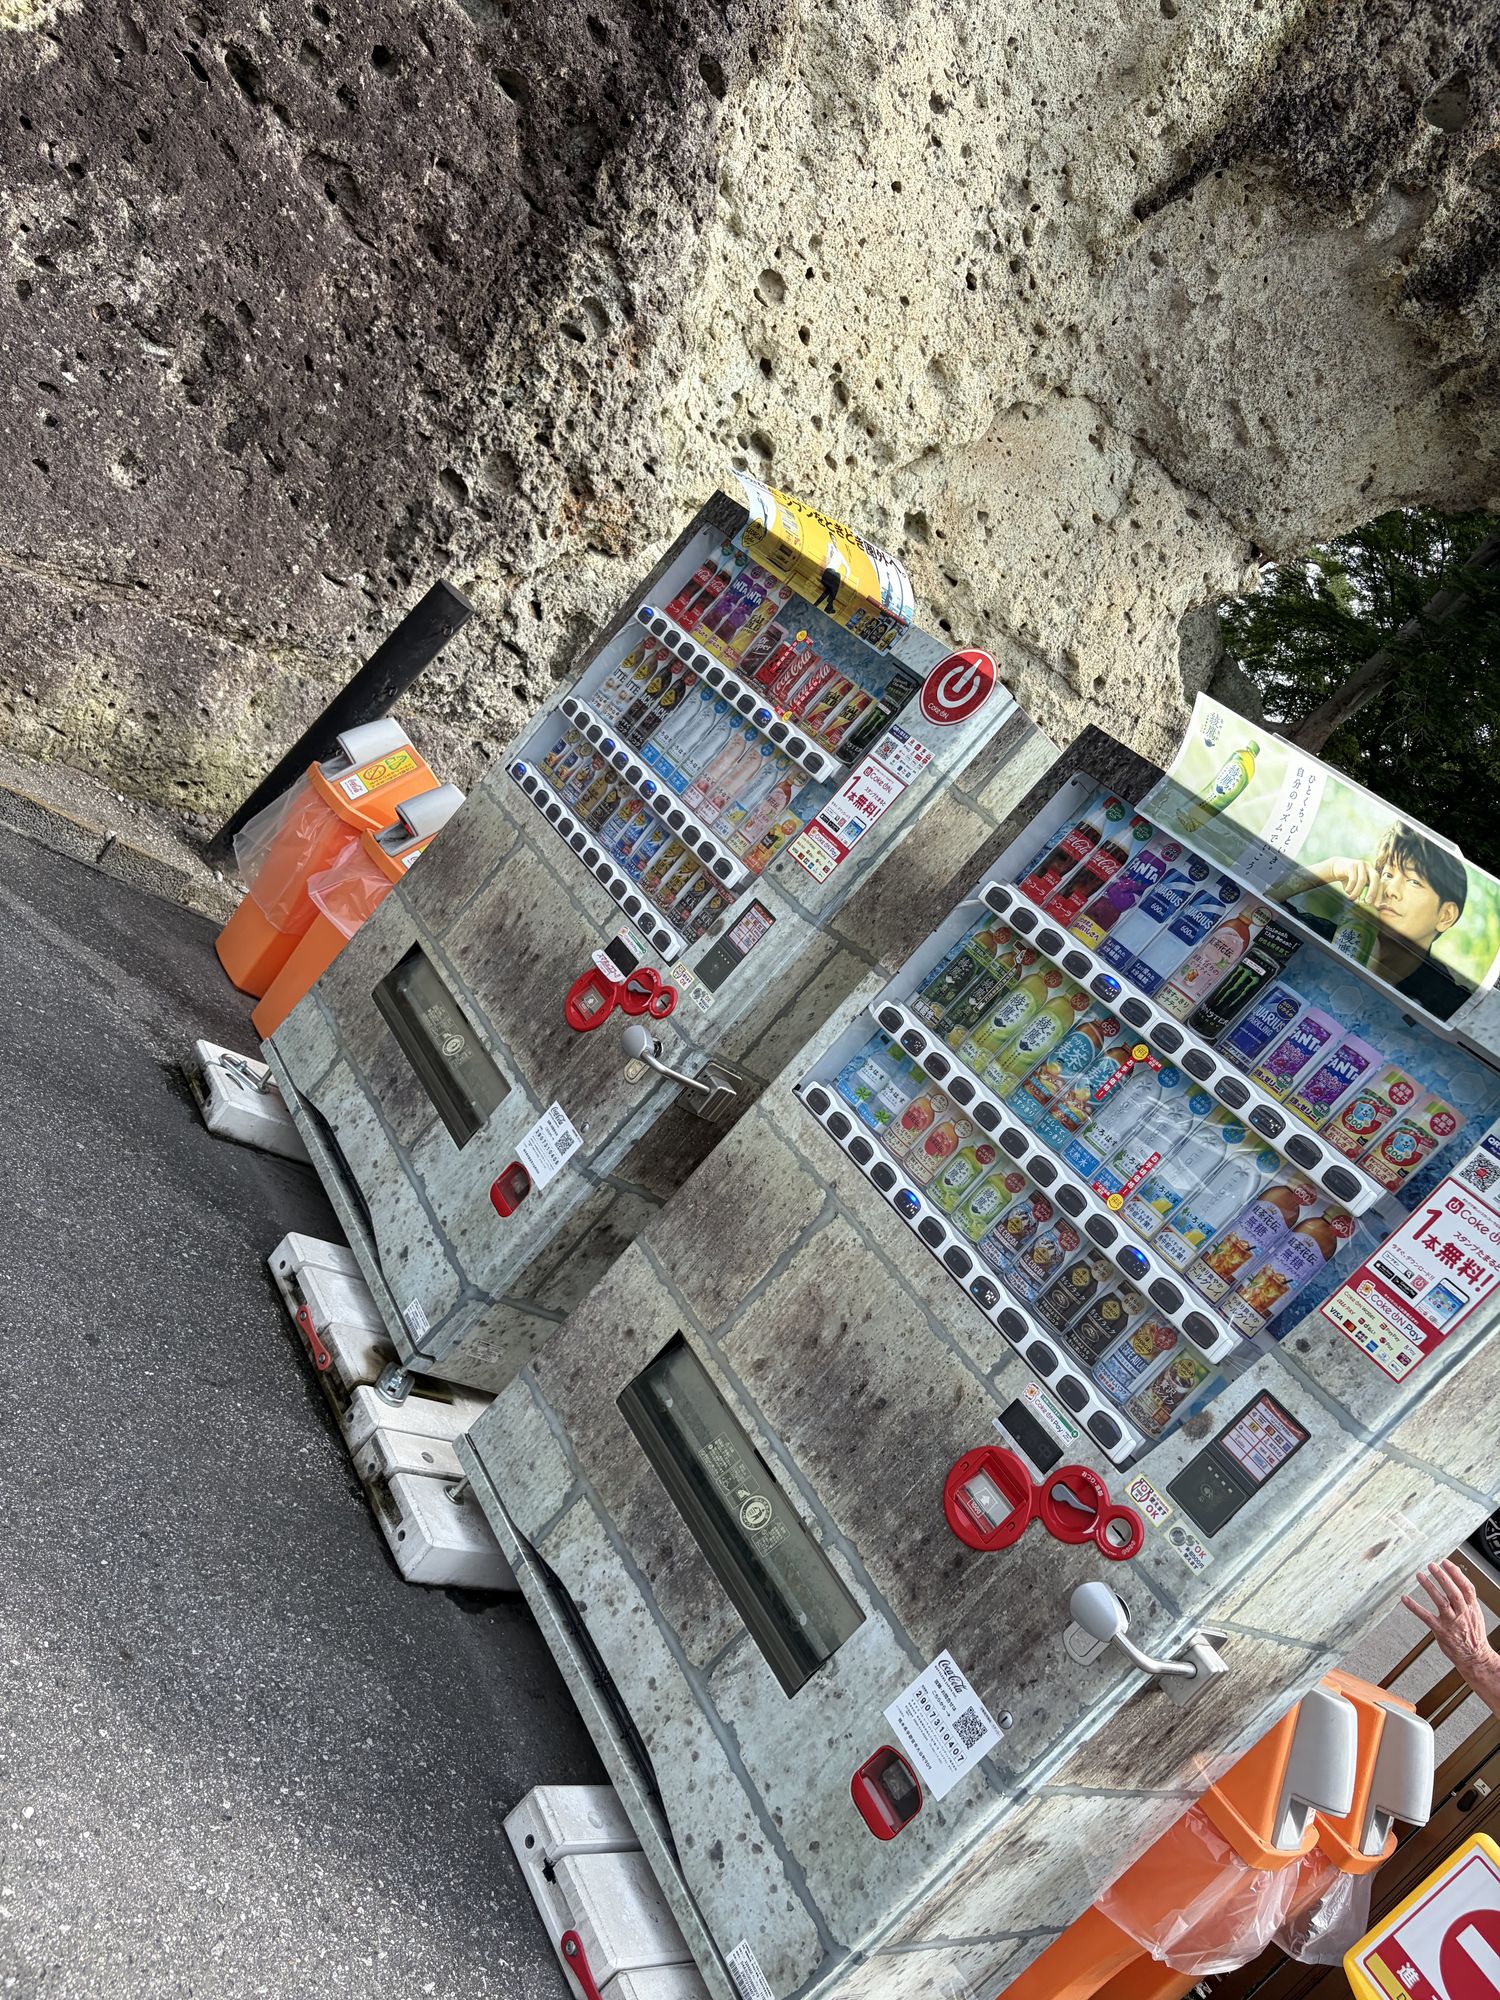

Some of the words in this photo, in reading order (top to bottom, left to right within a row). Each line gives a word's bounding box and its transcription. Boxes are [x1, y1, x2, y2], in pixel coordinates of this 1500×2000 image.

[868, 771, 885, 786] Coke
[842, 777, 881, 821] 1本無料!
[1245, 767, 1305, 875] 自分のリズムでいこう。
[1268, 774, 1316, 870] ひとくち、ひといき。
[1152, 881, 1183, 909] QUARIUS
[1182, 904, 1214, 931] QUARIUS
[678, 978, 686, 986] OK
[997, 989, 1028, 1023] 綾鷹
[1251, 1002, 1286, 1033] QUARIUS
[1023, 1014, 1054, 1047] 綾鷹
[1100, 1022, 1115, 1035] 650
[1053, 1039, 1089, 1072] 麦茶
[1097, 1058, 1134, 1098] お手頃価格!
[1344, 1113, 1364, 1130] Qoo
[1066, 1147, 1088, 1168] 天然水
[1384, 1144, 1404, 1162] Qoo
[1121, 1153, 1159, 1195] お手頃価格!
[1293, 1186, 1311, 1202] 650
[1243, 1215, 1268, 1238] 無糖
[1250, 1204, 1282, 1232] 紅茶花伝
[1330, 1218, 1348, 1234] 650
[1458, 1209, 1489, 1235] Coke
[999, 1229, 1019, 1247] COCOA
[1286, 1236, 1320, 1265] 紅茶花伝
[1279, 1246, 1305, 1271] 無糖
[1411, 1209, 1494, 1293] 1本無料!
[1453, 1231, 1500, 1271] スタンプたまると
[1026, 1259, 1047, 1278] COCOA
[1328, 1306, 1343, 1321] VISA
[1369, 1292, 1392, 1315] Coke
[1389, 1310, 1407, 1326] ON
[1402, 1322, 1423, 1344] Pay
[1134, 1336, 1152, 1352] GEORGIA
[1032, 1398, 1048, 1414] Coke
[1050, 1420, 1063, 1434] Pay
[1144, 1503, 1159, 1519] OK
[1148, 1496, 1167, 1516] 使えます
[1181, 1552, 1198, 1570] 使えます
[1193, 1544, 1207, 1559] OK
[936, 1657, 968, 1695] Coca-Cola
[930, 1690, 946, 1710] こちらから
